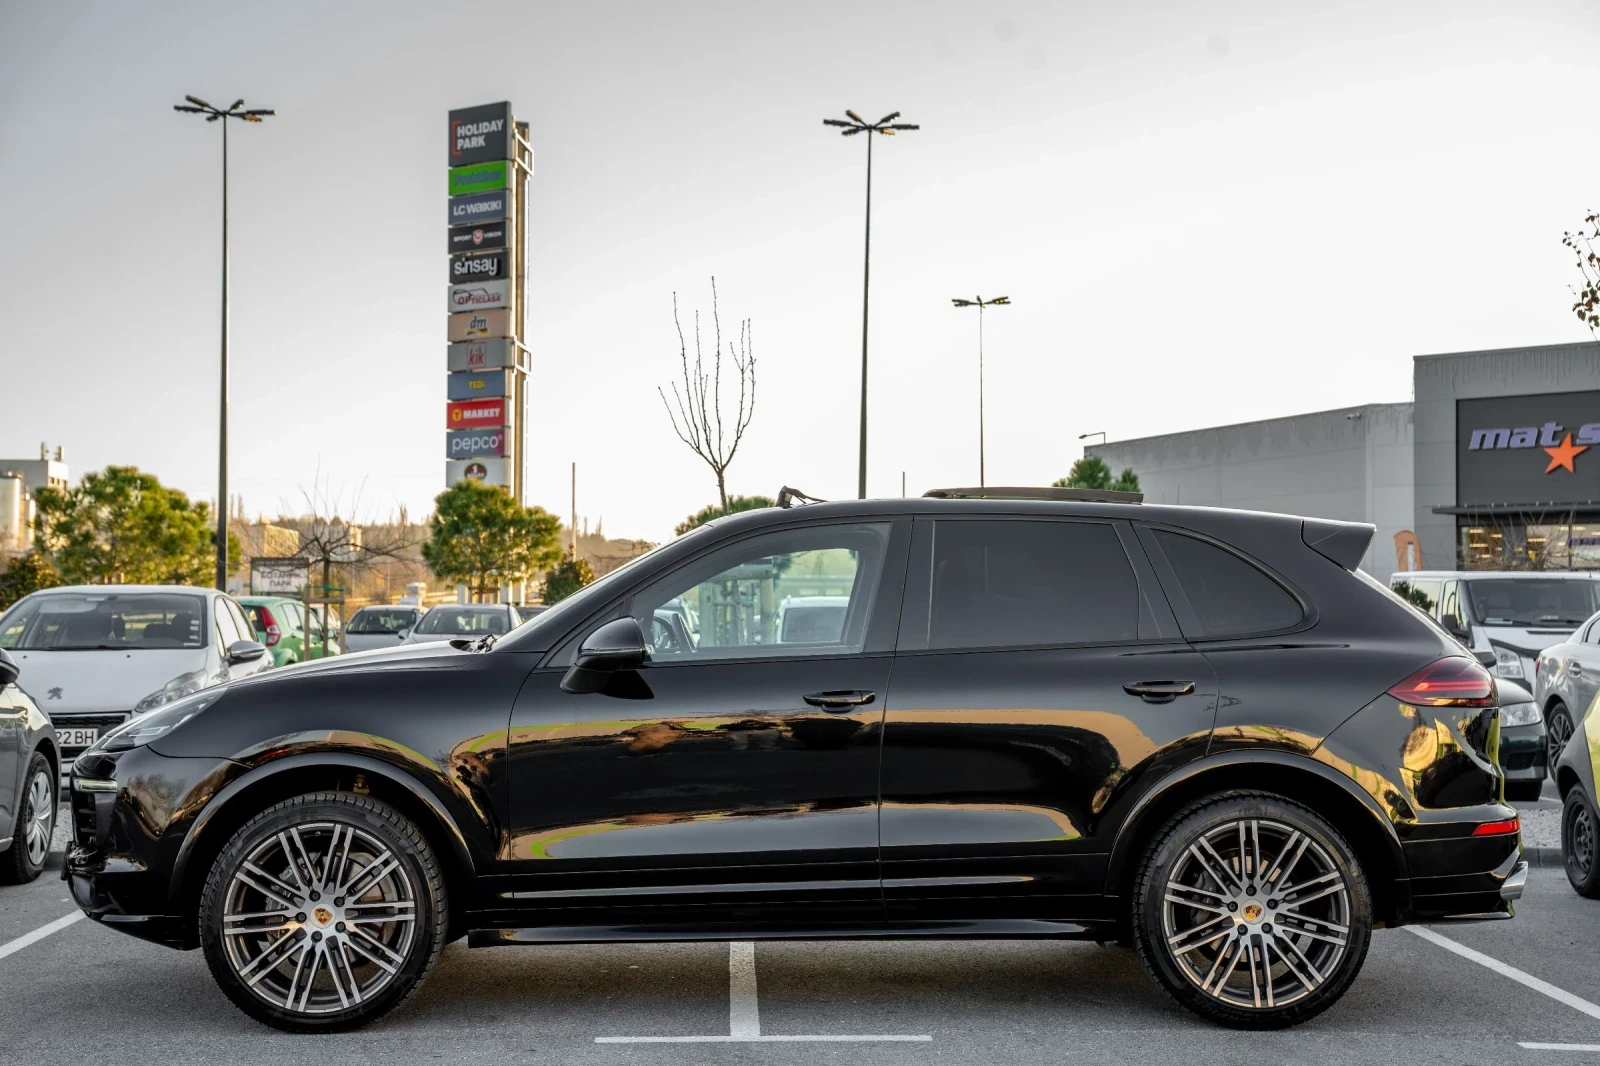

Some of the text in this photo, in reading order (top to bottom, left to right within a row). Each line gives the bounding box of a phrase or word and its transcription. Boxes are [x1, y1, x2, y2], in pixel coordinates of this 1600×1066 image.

[456, 119, 504, 137] HOLIDAY
[456, 134, 486, 150] PARK
[453, 204, 466, 216] LC
[453, 234, 472, 242] SPORT
[454, 257, 498, 276] sinsay
[470, 315, 487, 329] dm
[463, 408, 501, 419] MARKET
[1468, 421, 1564, 450] mat
[452, 435, 499, 453] pepco
[74, 730, 94, 745] BH
